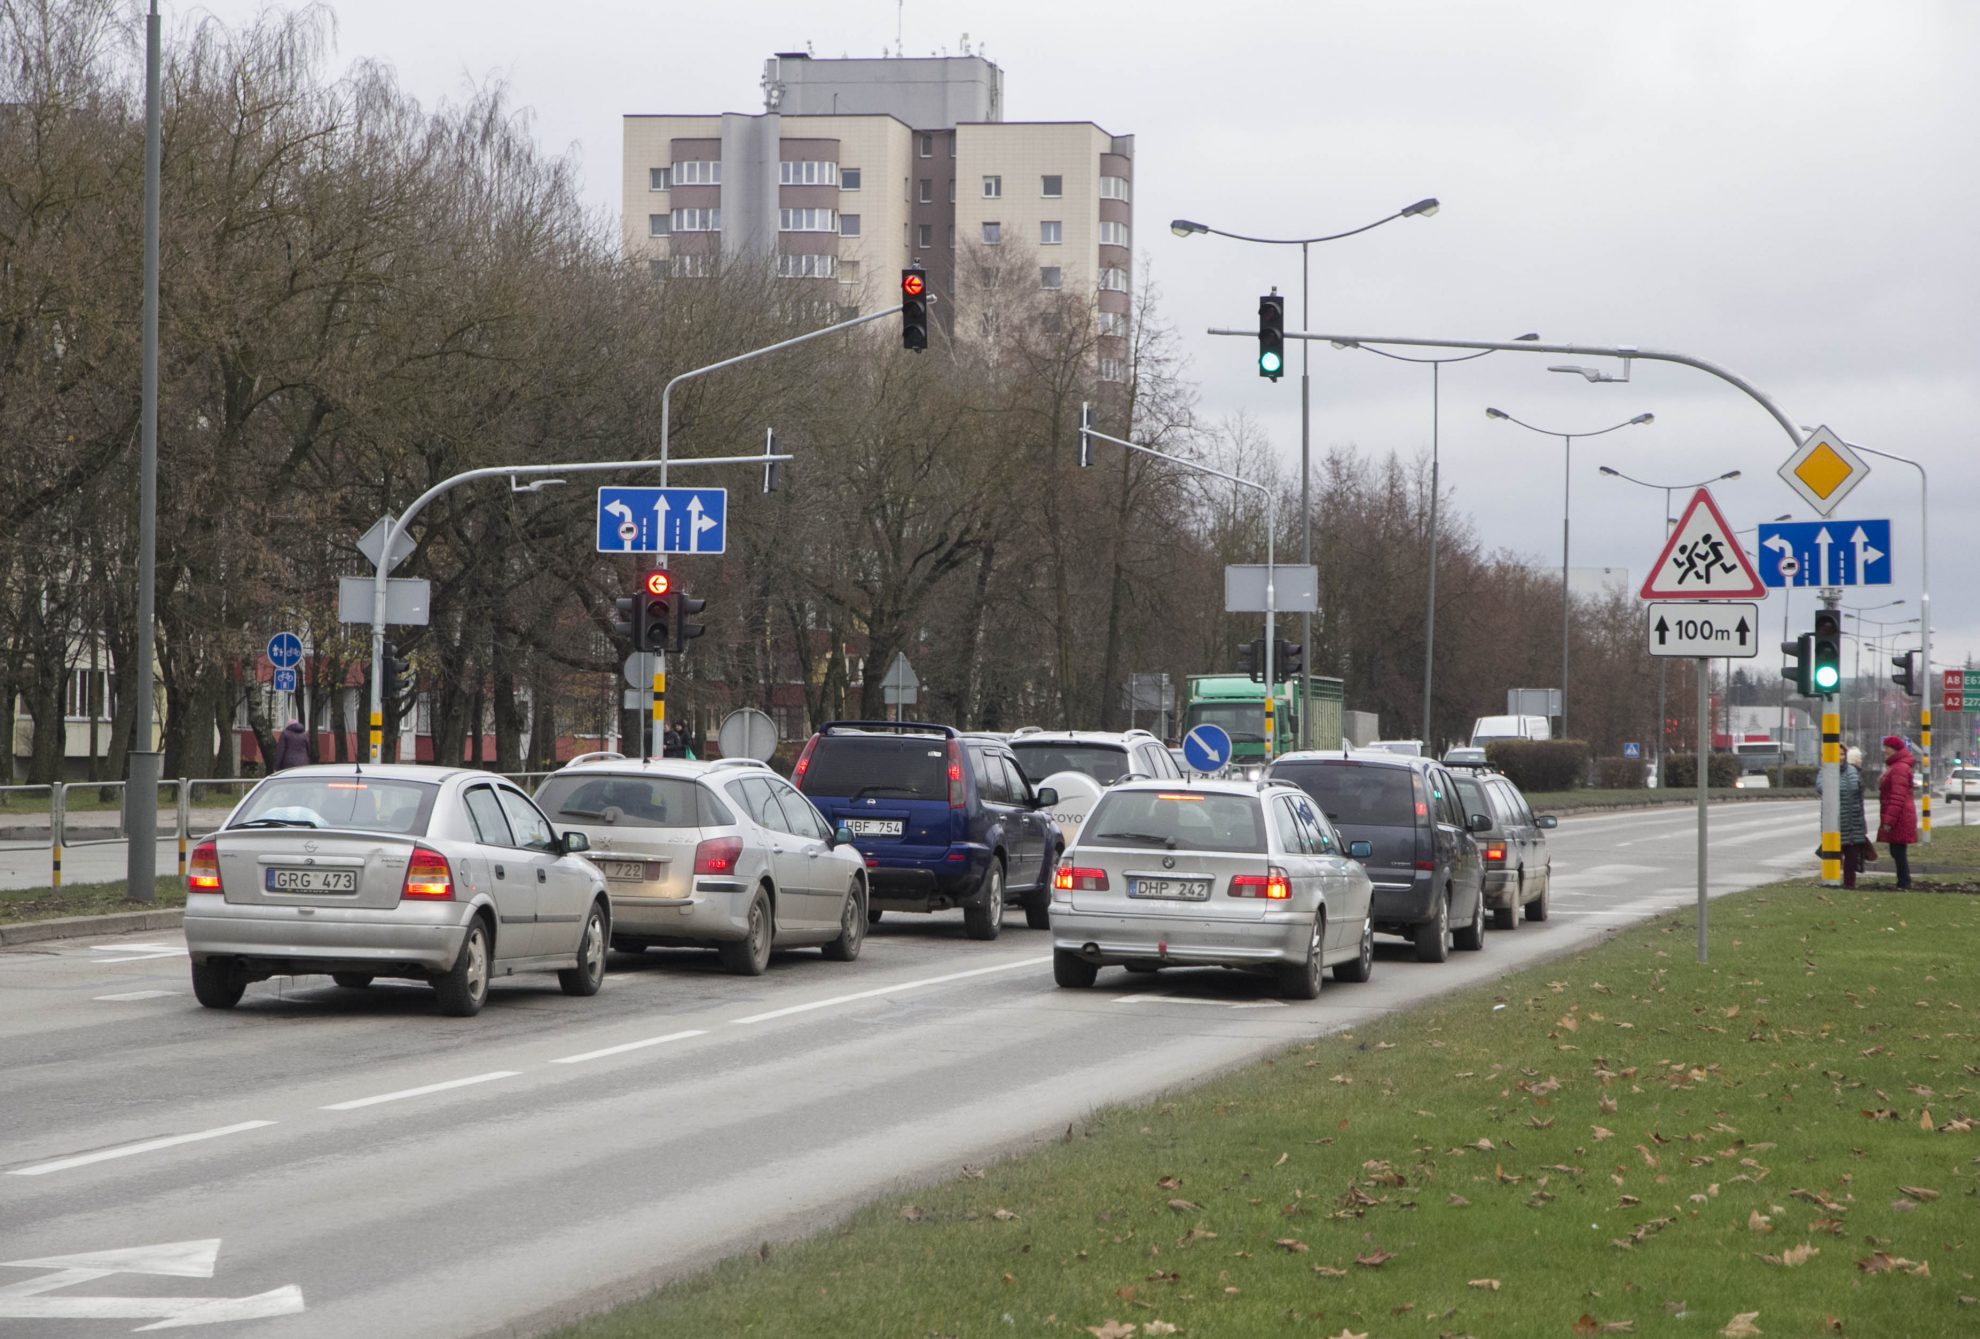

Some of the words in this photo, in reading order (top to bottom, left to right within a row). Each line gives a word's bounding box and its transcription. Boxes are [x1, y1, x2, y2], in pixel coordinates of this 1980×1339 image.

[1675, 620, 1730, 640] 100m
[1946, 697, 1960, 706] A2
[846, 820, 871, 832] HBF
[879, 822, 900, 833] 754
[615, 863, 641, 877] 722
[277, 872, 311, 888] GRG
[322, 873, 352, 889] 473
[1138, 881, 1169, 894] DHP
[1179, 883, 1205, 897] 242
